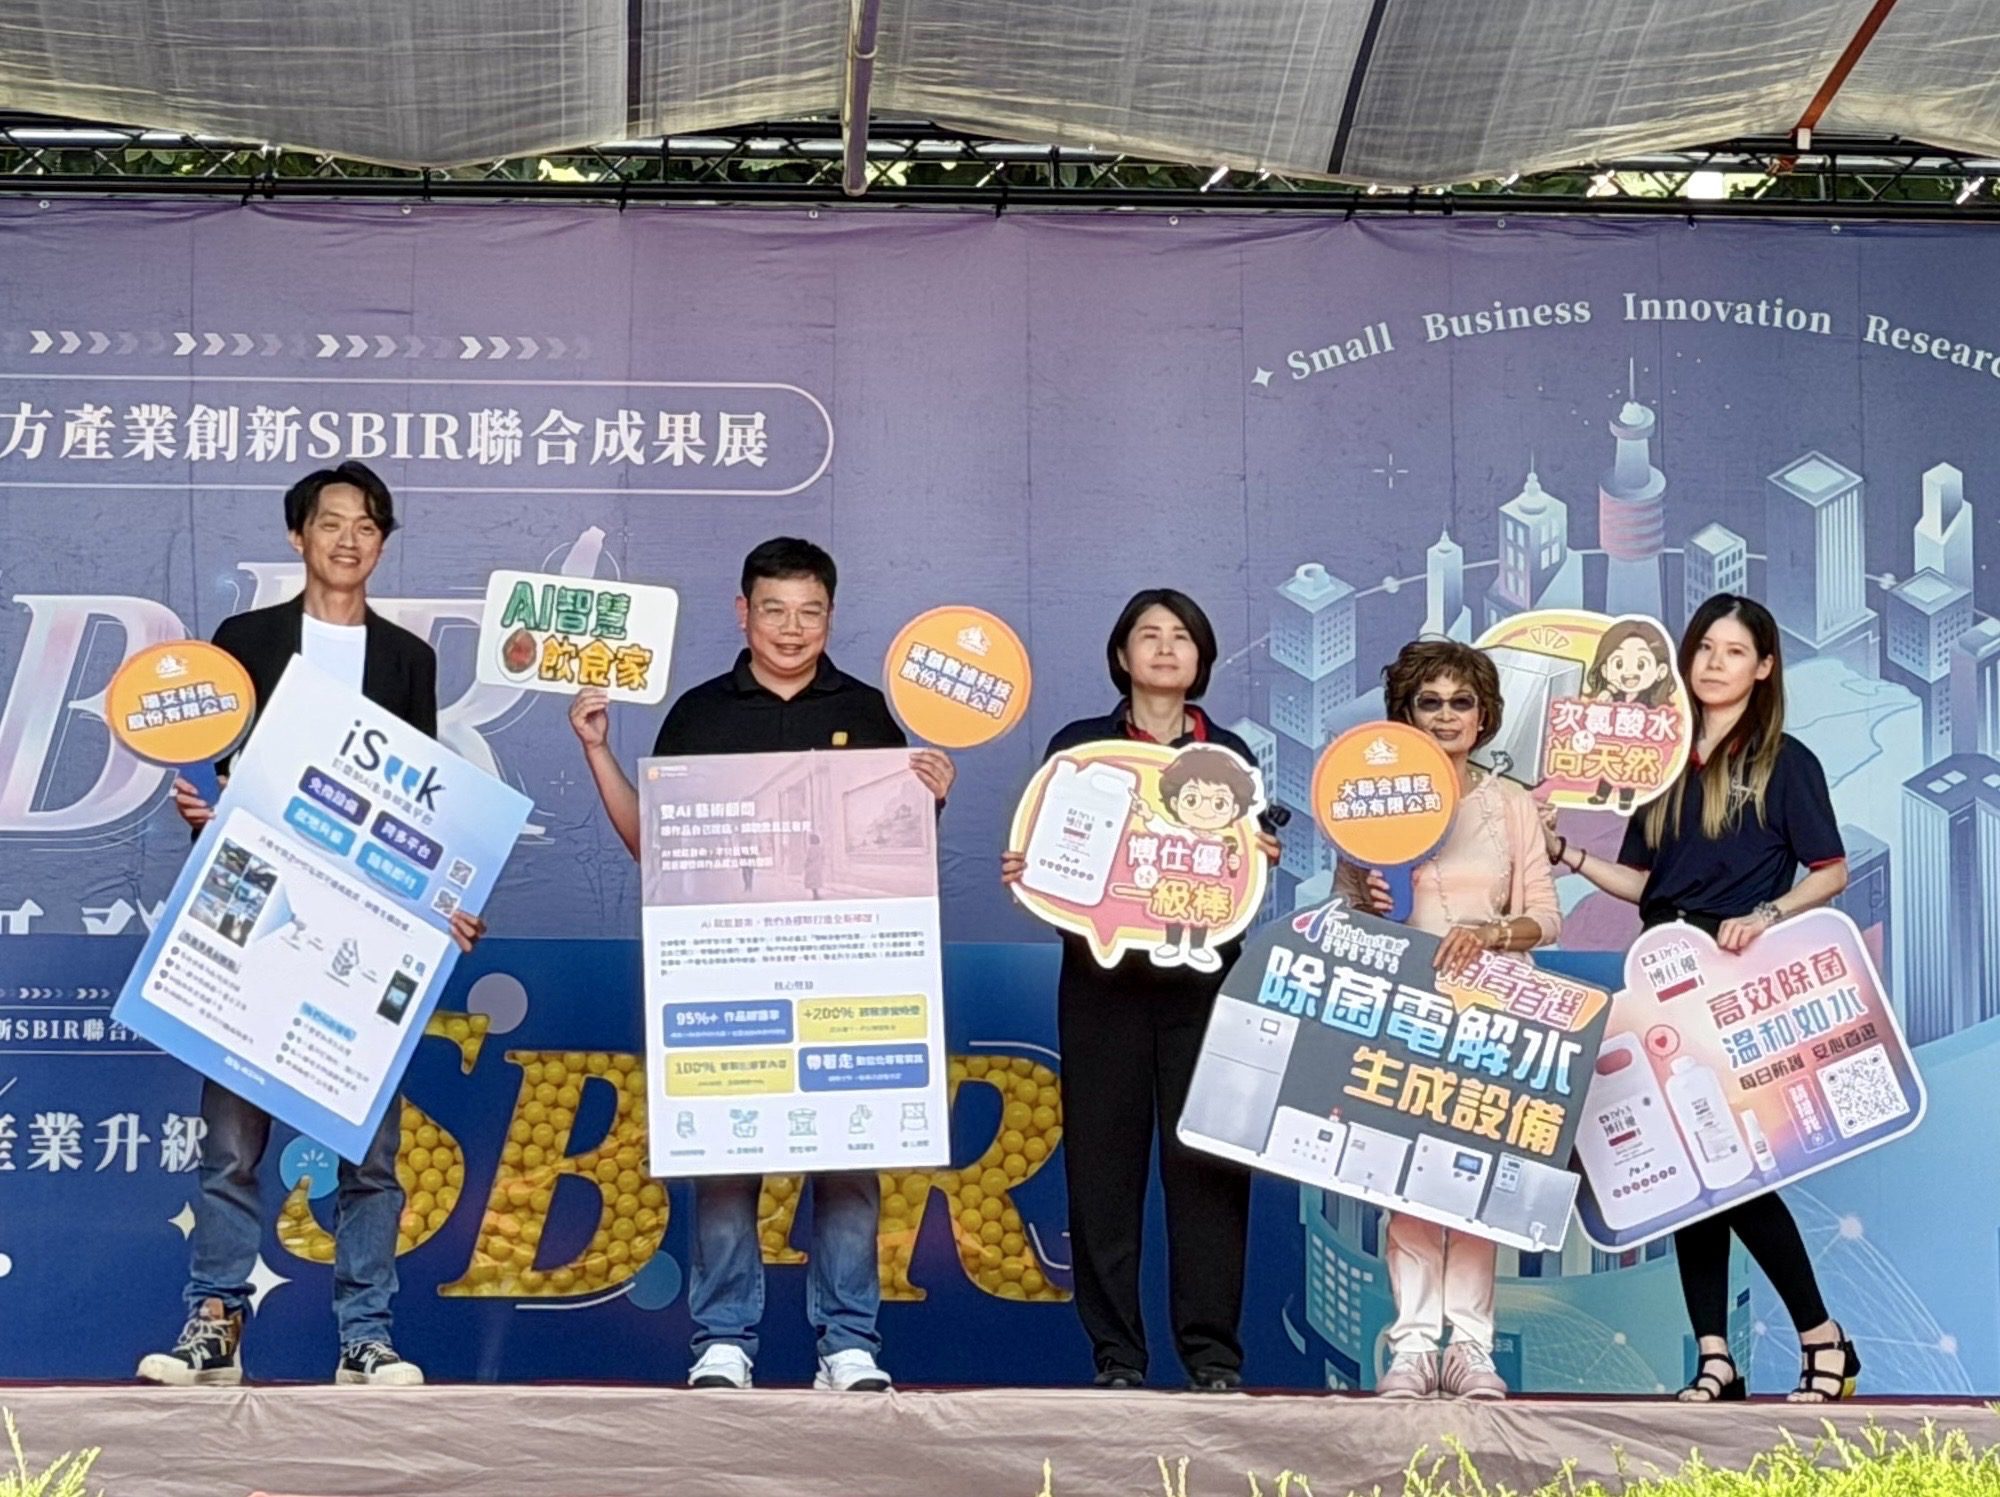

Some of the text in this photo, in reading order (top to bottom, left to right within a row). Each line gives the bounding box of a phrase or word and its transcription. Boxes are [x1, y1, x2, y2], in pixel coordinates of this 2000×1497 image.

[1287, 321, 1395, 381] Small
[1421, 298, 1592, 344] Business
[1622, 292, 1832, 335] Innovation
[0, 402, 771, 468] 方產業創新SBIR聯合成果展
[501, 581, 632, 641] AI智慧
[538, 634, 654, 690] 飲食家
[1551, 700, 1680, 743] 次氯酸水
[1546, 736, 1662, 785] 尚天然
[1330, 793, 1442, 821] 股份有限公司
[1128, 835, 1225, 877] 博仕優
[1112, 878, 1233, 922] 一級棒
[1706, 945, 1850, 1031] 高效除菌
[0, 1018, 144, 1042] 新SBIR聯合
[1257, 945, 1583, 1096] 除菌電解水
[1721, 986, 1868, 1069] 溫和如水
[1343, 1045, 1567, 1157] 生成設備
